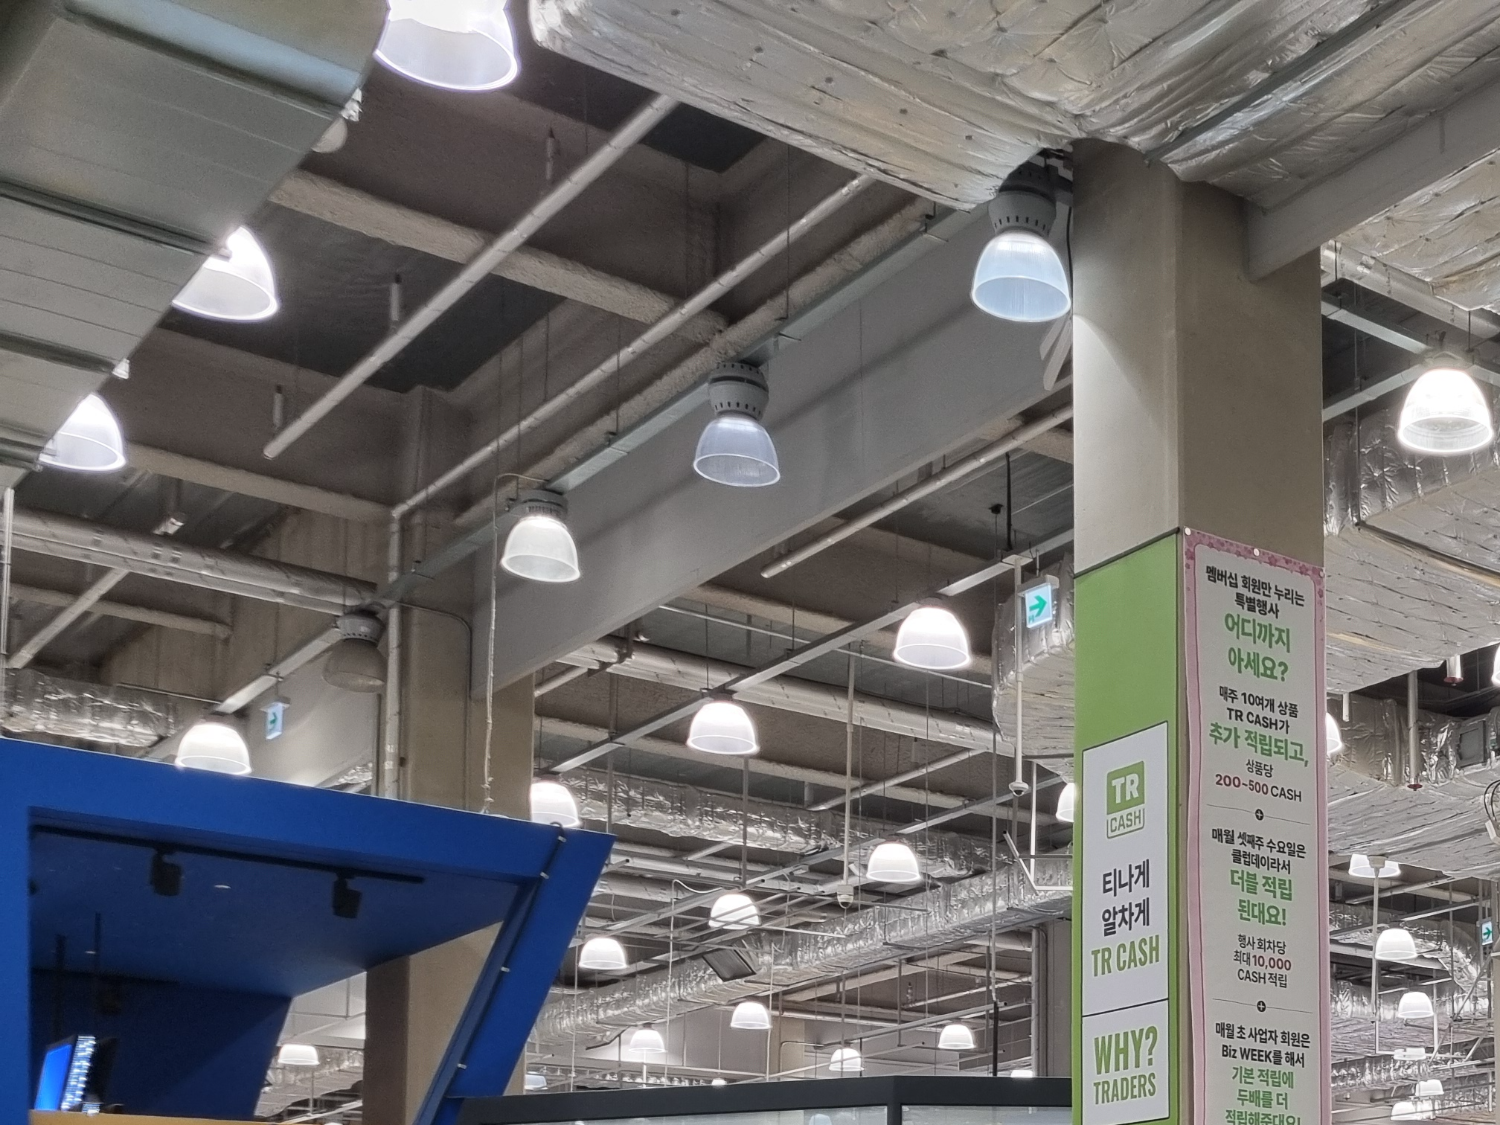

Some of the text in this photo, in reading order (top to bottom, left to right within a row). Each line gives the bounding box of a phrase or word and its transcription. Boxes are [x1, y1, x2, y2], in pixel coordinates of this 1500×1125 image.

[1205, 565, 1305, 607] 멤버십 회원만 누리는
[1234, 593, 1279, 619] 특별행사
[1224, 613, 1290, 653] 어디까지
[1228, 648, 1288, 682] 아세요?
[1111, 773, 1139, 804] TR
[1109, 811, 1143, 833] CASH
[1102, 858, 1150, 897] 티나게
[1101, 897, 1150, 937] 알차게
[1091, 934, 1159, 977] TR CASH
[1094, 1025, 1158, 1075] WHY?
[1093, 1072, 1156, 1105] TRADERS
